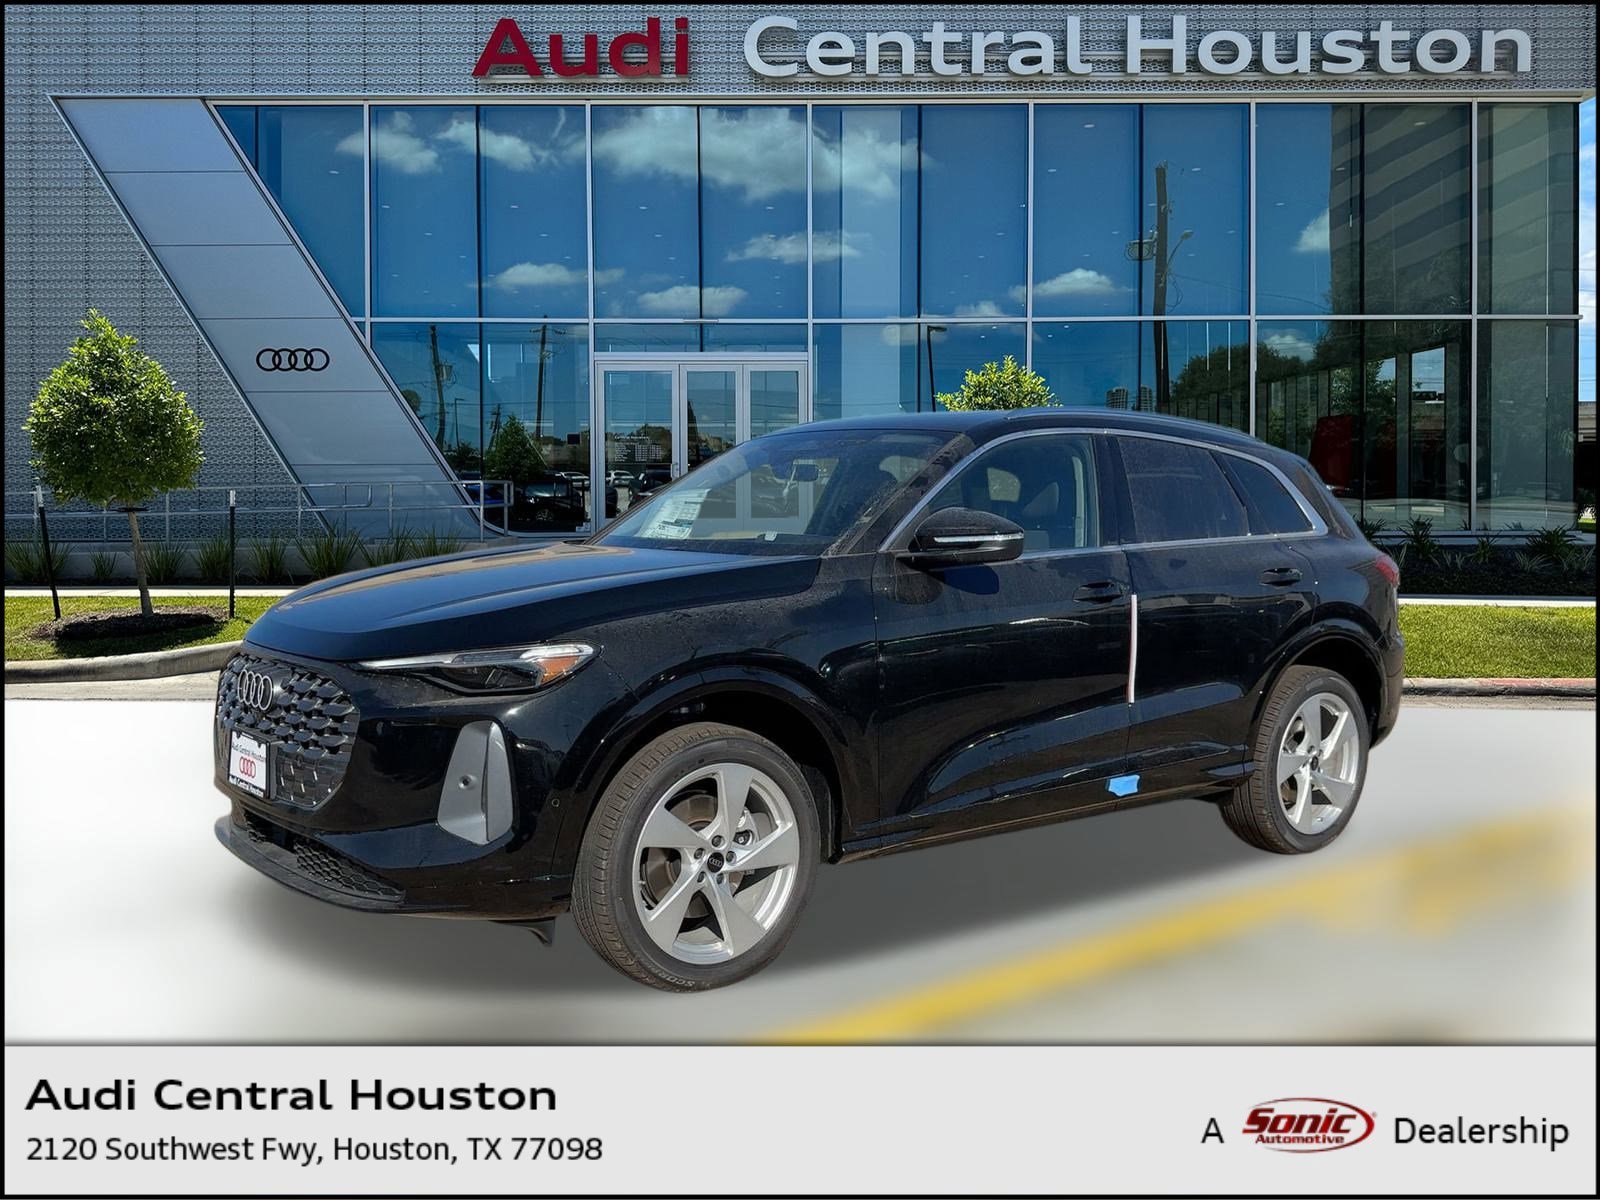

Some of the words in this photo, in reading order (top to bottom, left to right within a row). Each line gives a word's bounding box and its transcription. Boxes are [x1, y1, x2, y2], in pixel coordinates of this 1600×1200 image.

[472, 17, 689, 78] Audi
[743, 15, 1093, 77] Central
[1125, 15, 1532, 75] Houston
